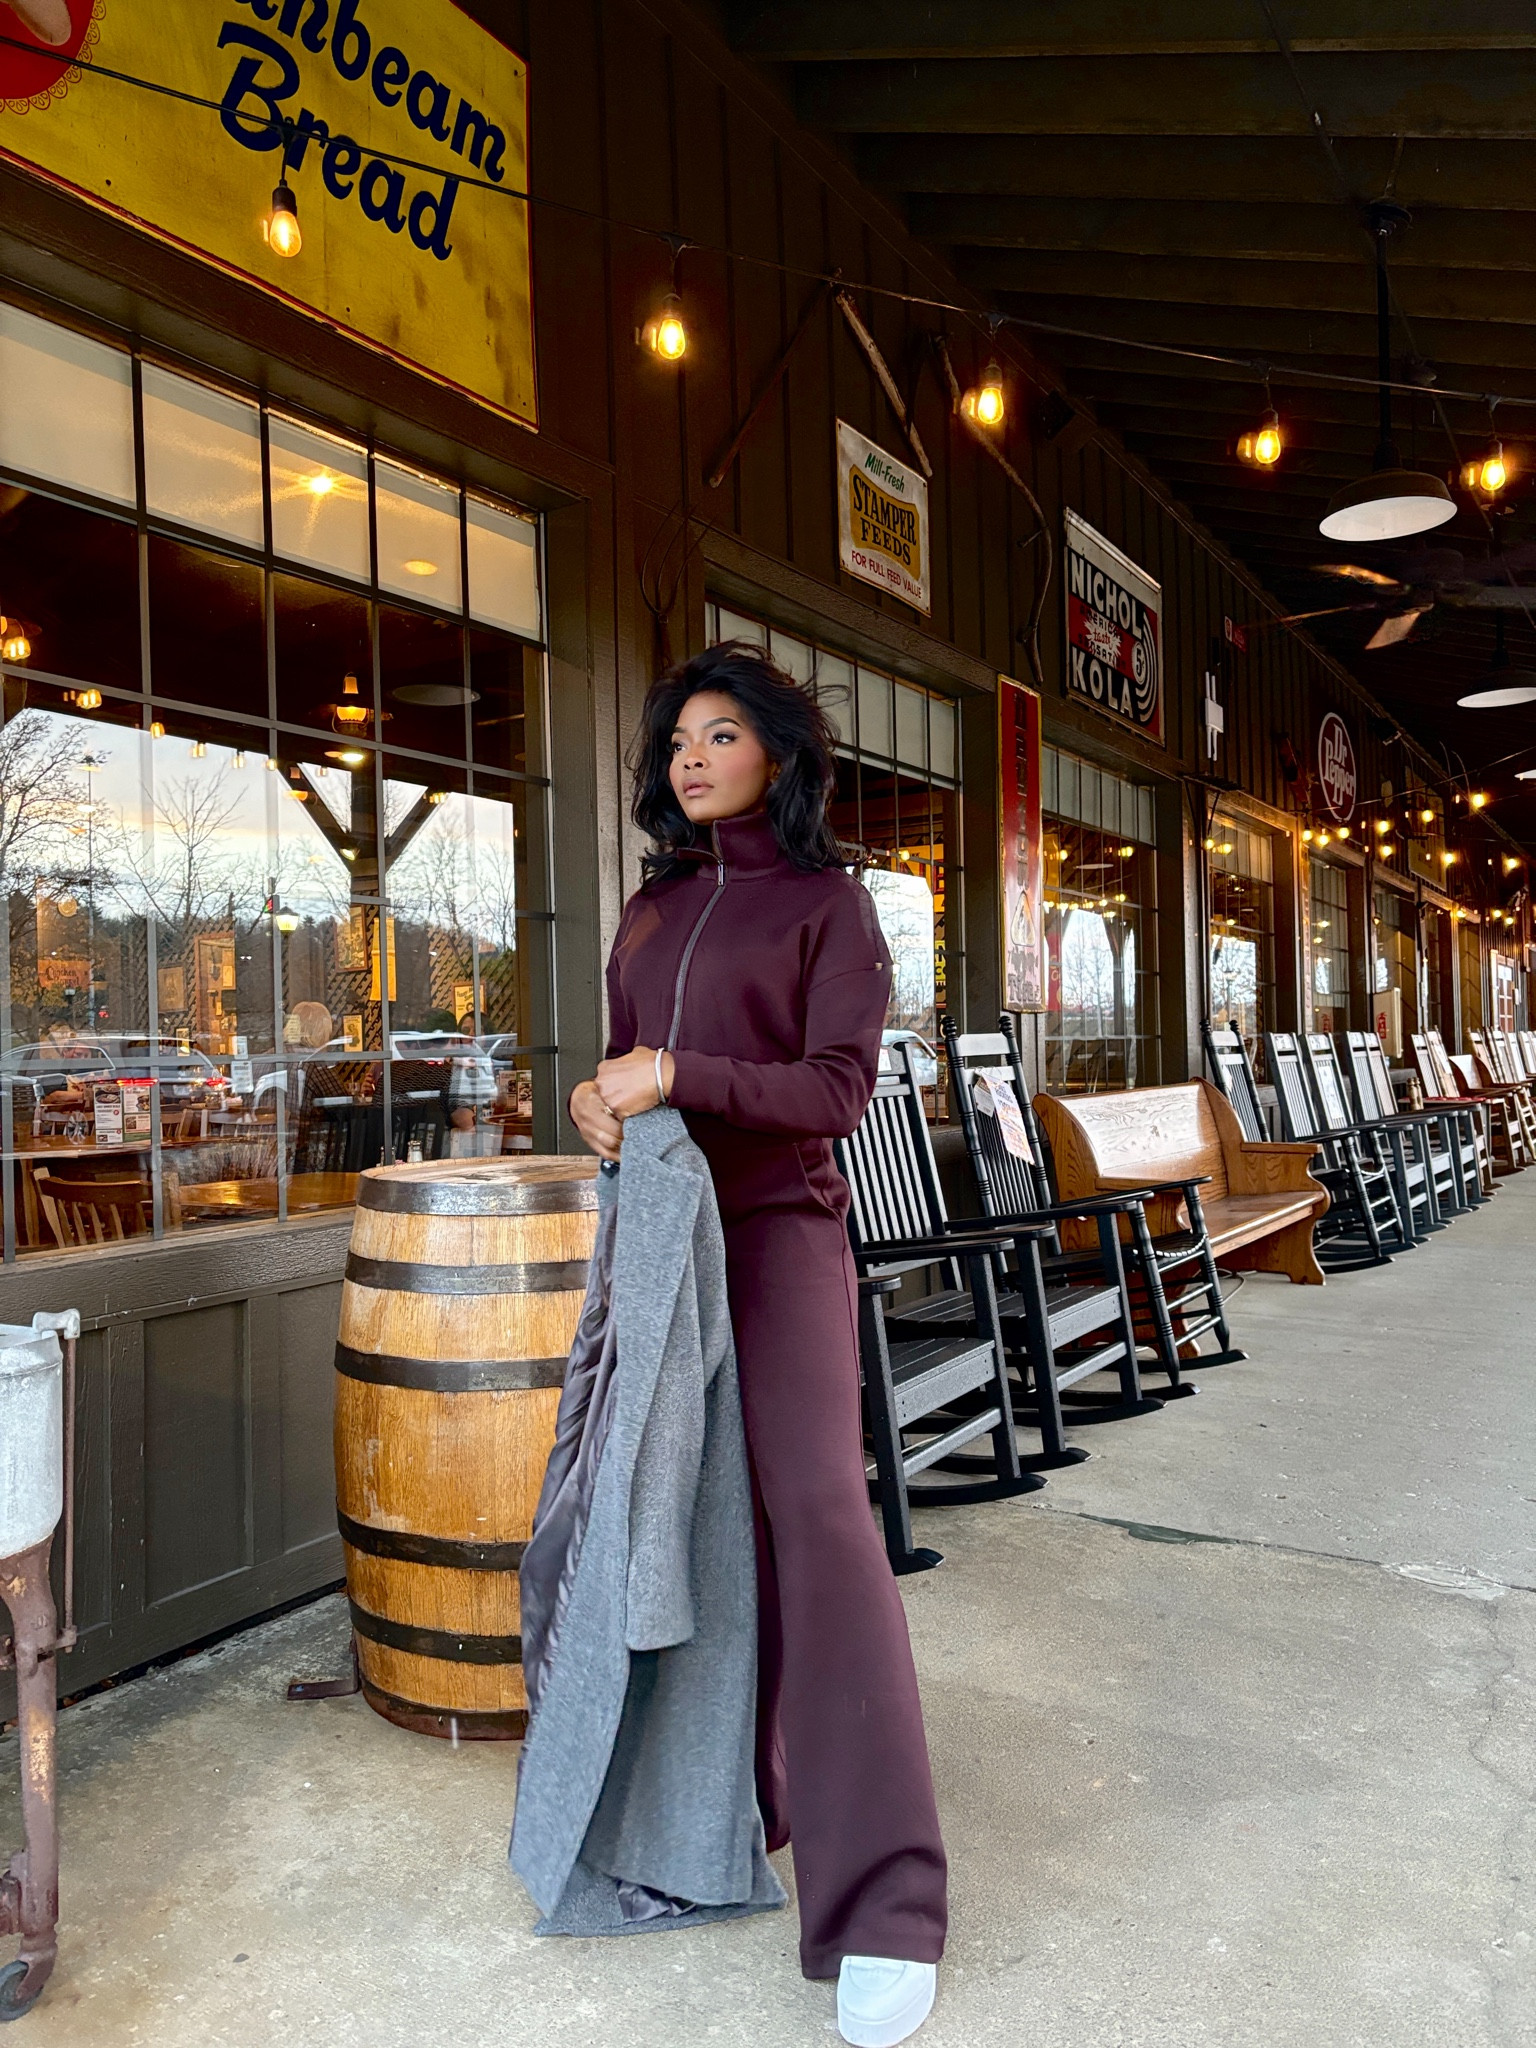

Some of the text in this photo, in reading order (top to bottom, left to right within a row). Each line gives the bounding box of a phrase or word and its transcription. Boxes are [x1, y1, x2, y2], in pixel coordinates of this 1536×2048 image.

[217, 21, 460, 260] Bread
[864, 452, 905, 494] Mill-Fresh
[853, 473, 917, 546] STAMPER
[860, 517, 911, 566] FEEDS
[851, 549, 922, 599] FOR FULL FEED VALUE
[1070, 551, 1142, 640] NICHOL
[1071, 645, 1134, 719] KOLA
[1323, 736, 1355, 806] Pepper
[1333, 722, 1347, 767] Dr
